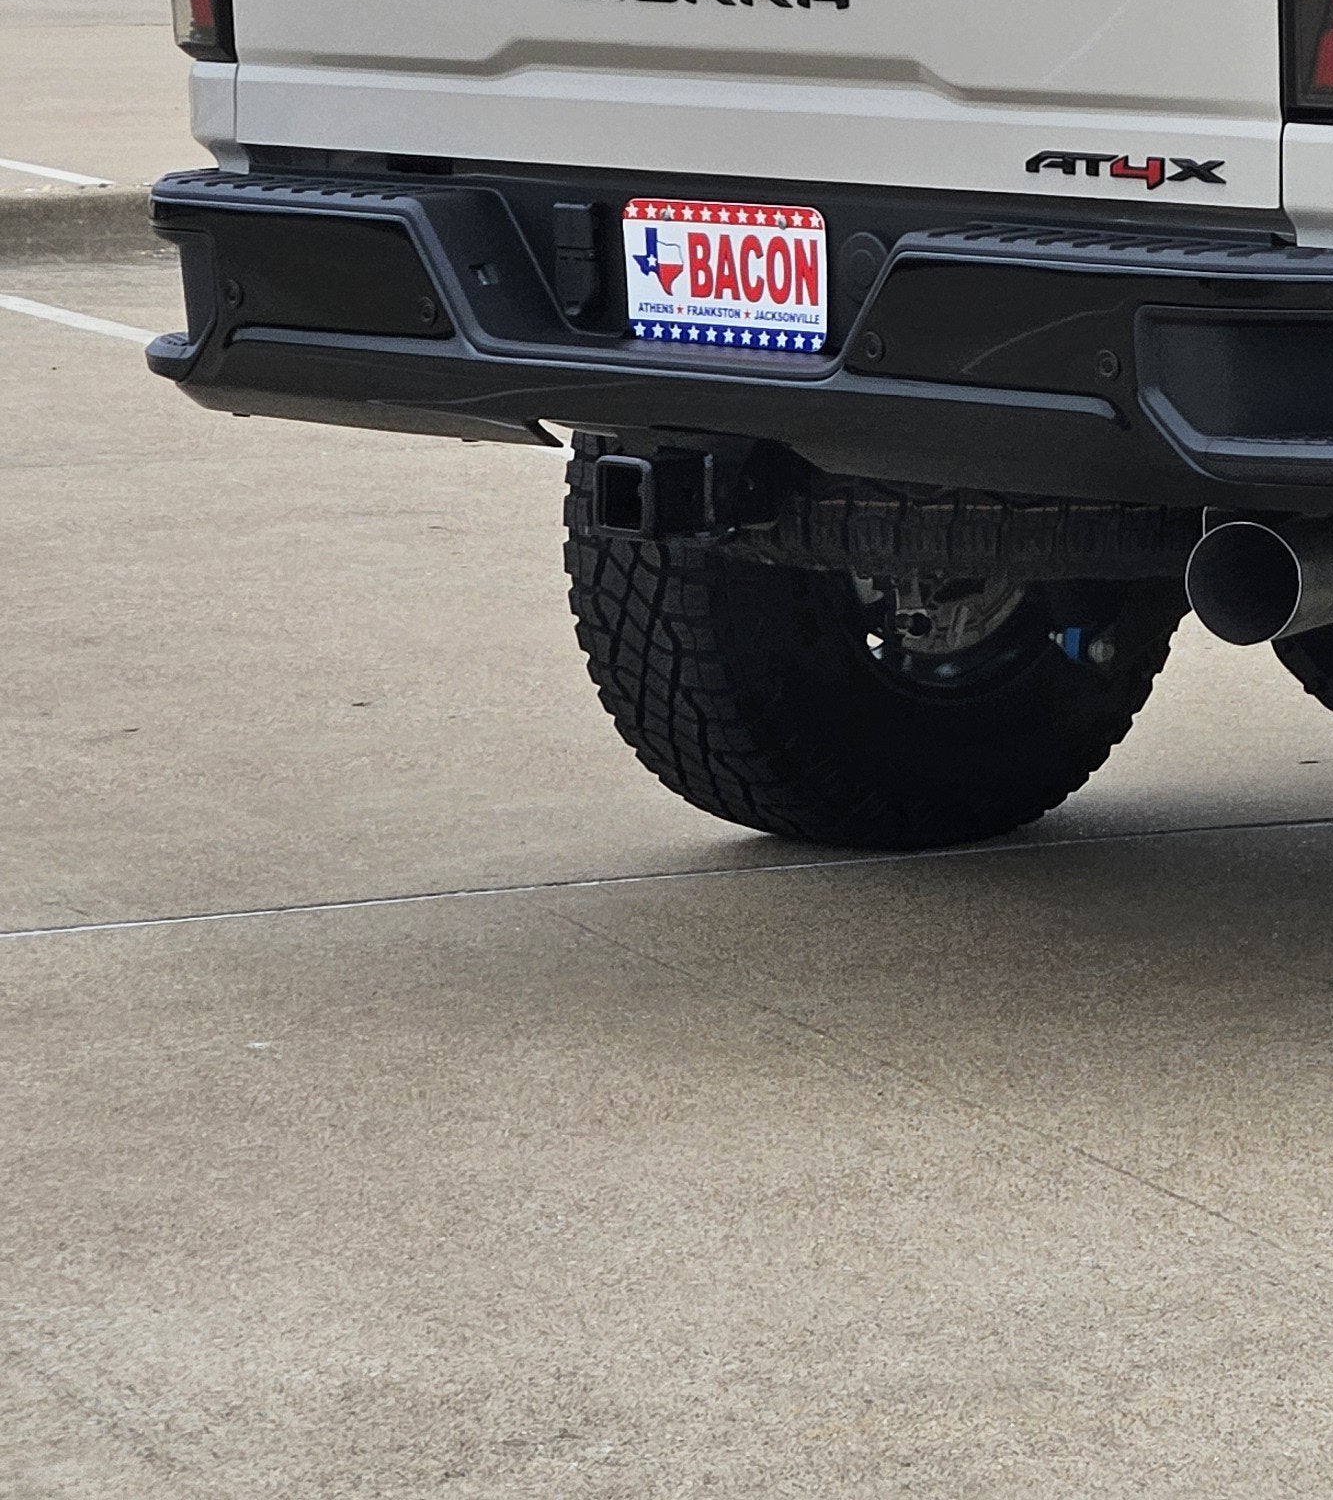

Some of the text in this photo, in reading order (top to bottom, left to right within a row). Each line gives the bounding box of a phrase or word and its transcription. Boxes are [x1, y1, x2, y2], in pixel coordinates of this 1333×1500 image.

[1025, 150, 1226, 190] AT4X
[687, 232, 819, 307] BACON
[638, 301, 820, 325] ATHENS FRANKSTON JACKSONVILLE
